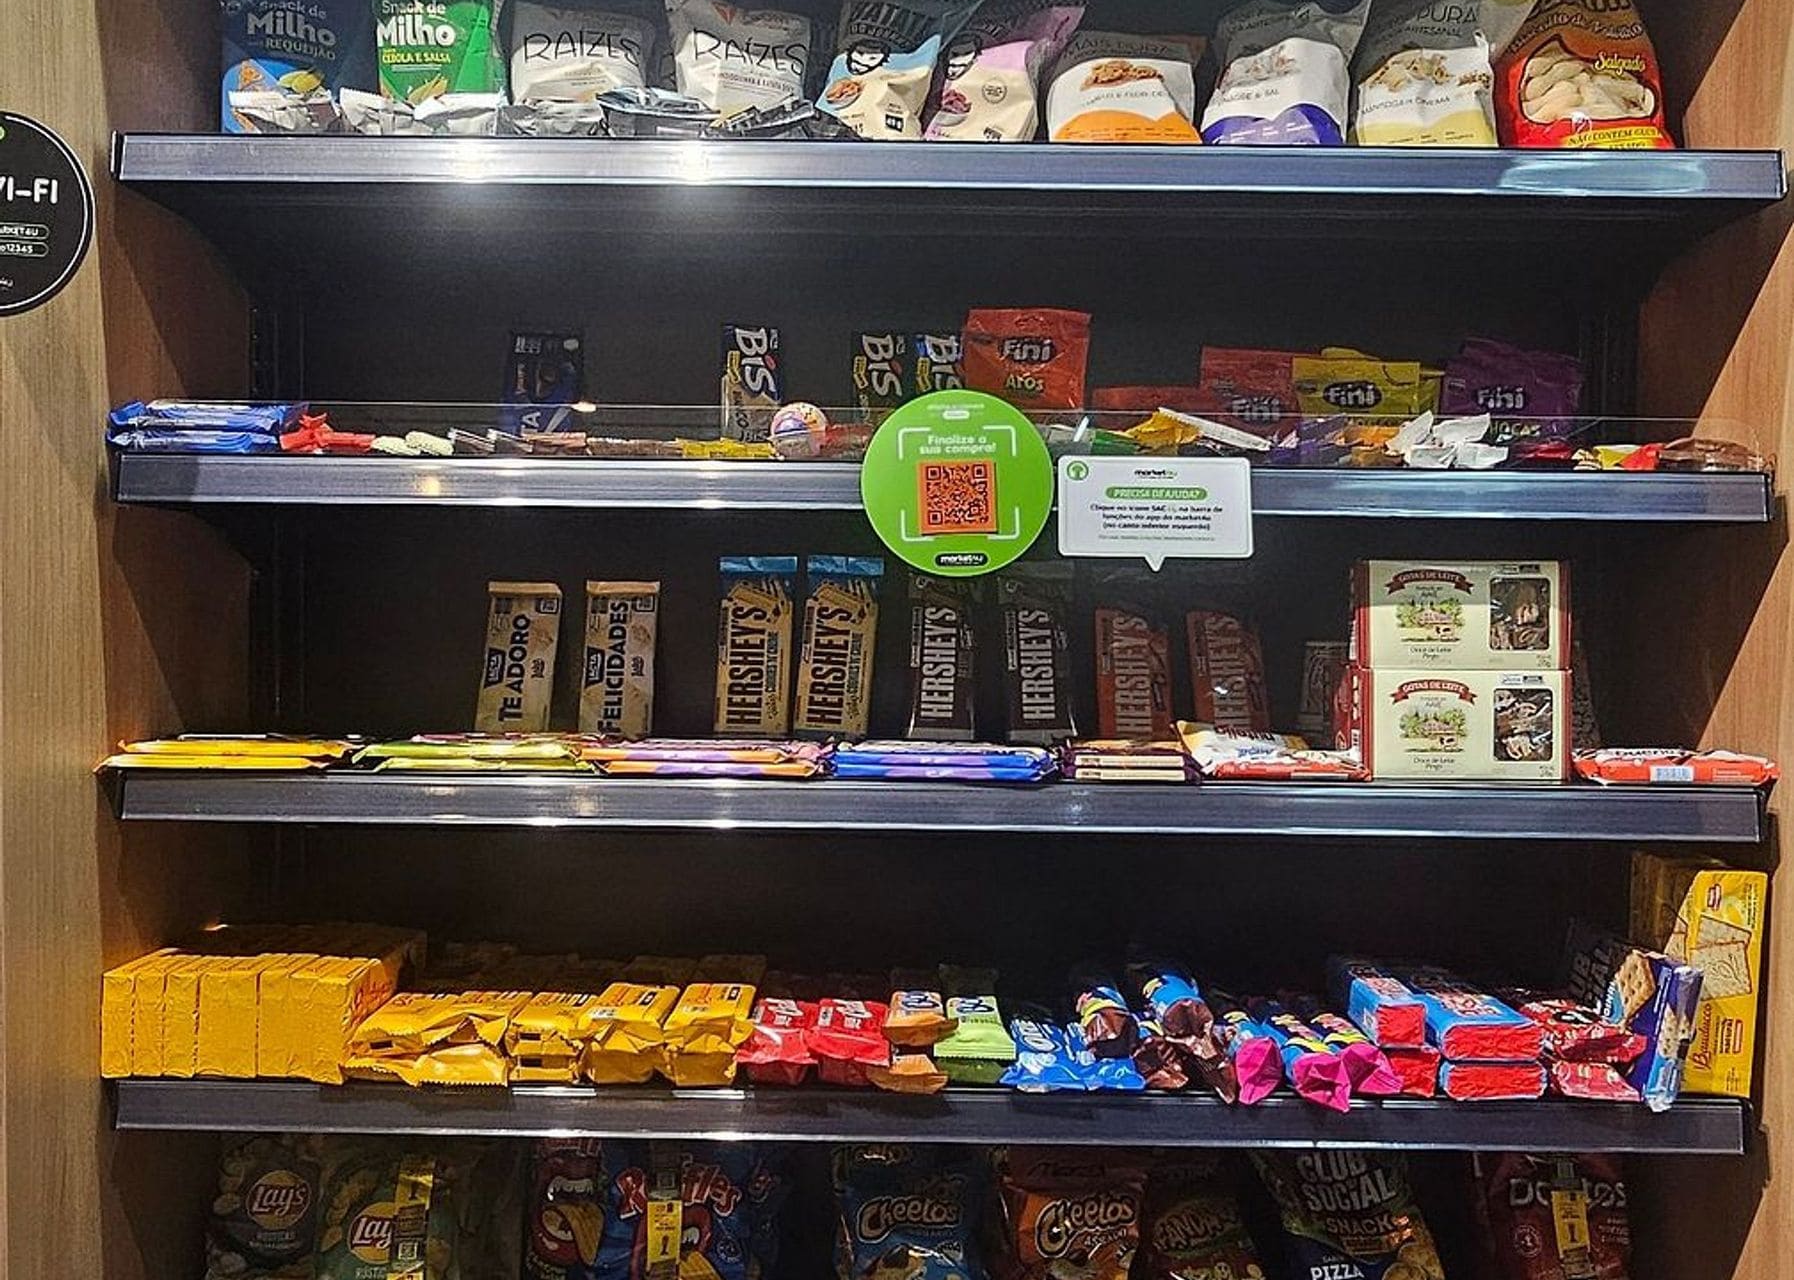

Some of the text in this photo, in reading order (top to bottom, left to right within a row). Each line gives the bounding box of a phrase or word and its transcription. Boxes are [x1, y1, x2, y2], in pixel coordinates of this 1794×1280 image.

[247, 10, 337, 48] Milho
[377, 18, 457, 48] Milho
[381, 0, 447, 15] Snack de
[1594, 51, 1646, 75] Salgado
[735, 327, 776, 395] BIS
[862, 334, 903, 398] BIS
[1003, 337, 1052, 362] Fini
[1007, 372, 1044, 391] Aros
[1328, 384, 1375, 407] Fini
[506, 612, 531, 695] ADORO
[599, 600, 629, 736] FELICIDADES
[726, 605, 768, 726] HERSHEY'S
[807, 605, 853, 726] HERSHEY'S
[920, 606, 957, 719] HERSHEY'S
[1018, 608, 1056, 720] HERSHEY'S
[1113, 614, 1152, 734] HERSHEY'S
[1692, 1003, 1713, 1071] Bauducco
[252, 1184, 308, 1213] Lay's
[858, 1195, 960, 1243] Cheetos
[1300, 1170, 1397, 1212] SOCIAL
